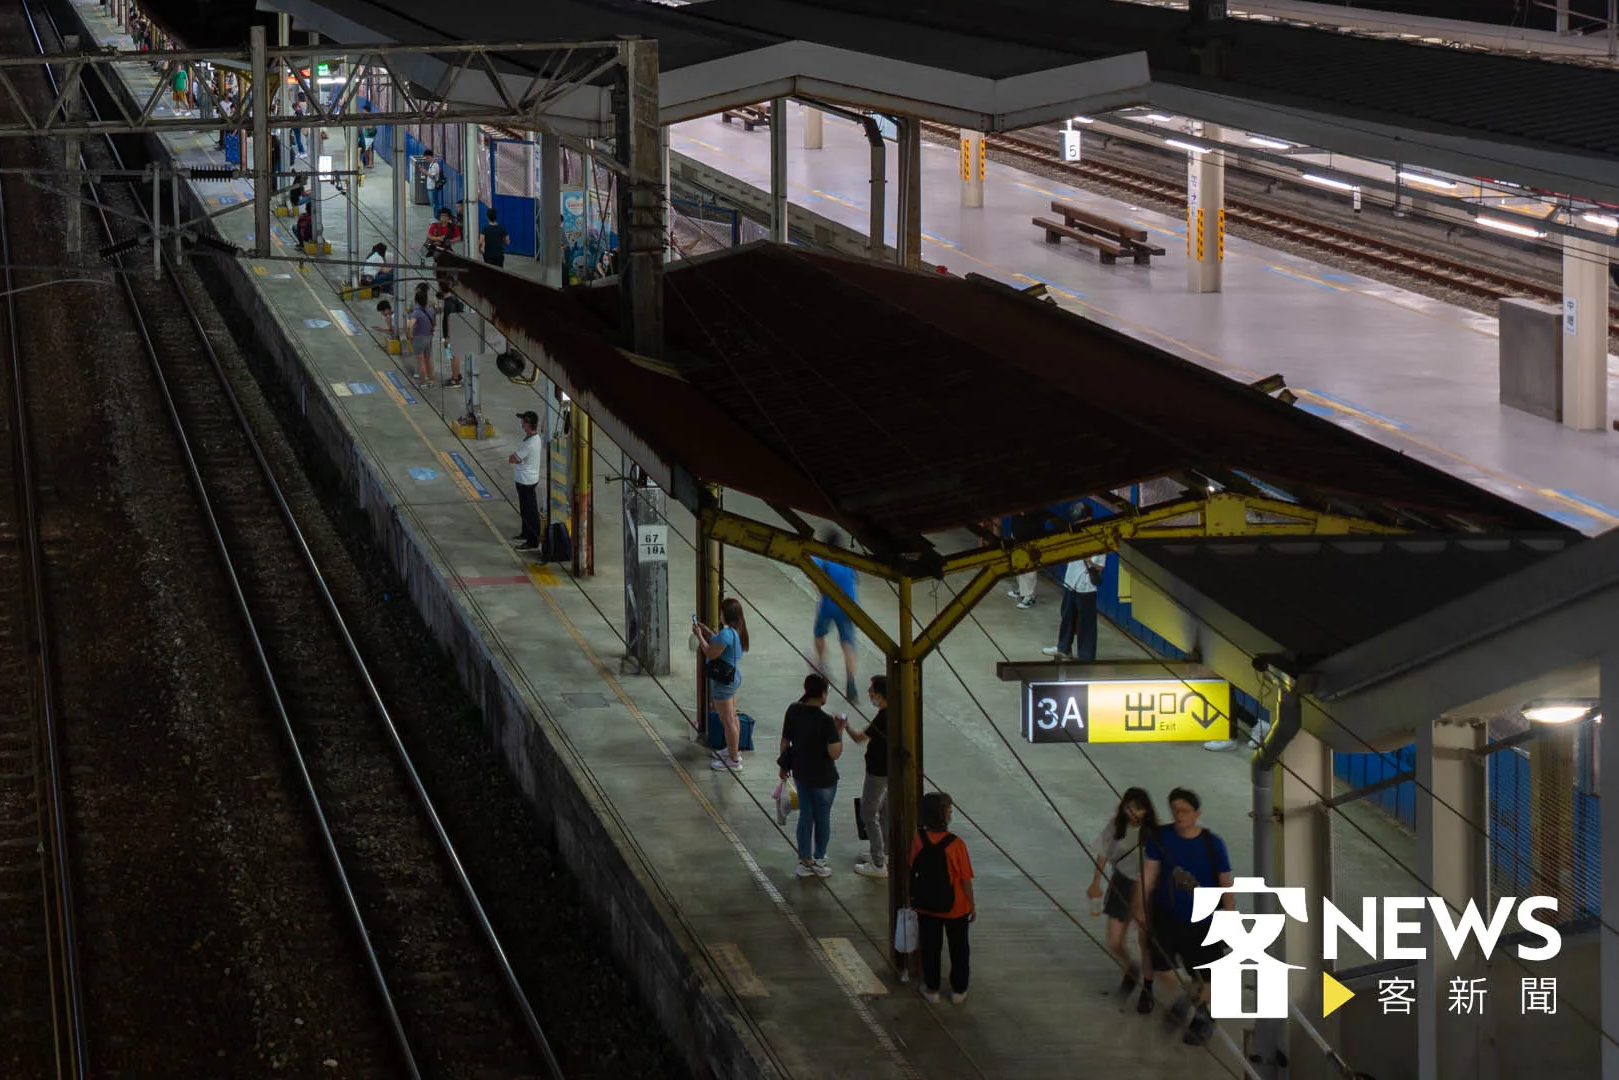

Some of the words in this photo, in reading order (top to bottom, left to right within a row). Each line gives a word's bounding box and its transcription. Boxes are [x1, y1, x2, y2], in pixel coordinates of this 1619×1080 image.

[1069, 144, 1077, 158] 5
[645, 533, 659, 543] 67
[1037, 696, 1085, 730] 3A
[1124, 691, 1176, 731] 出口
[1159, 720, 1176, 732] Exit
